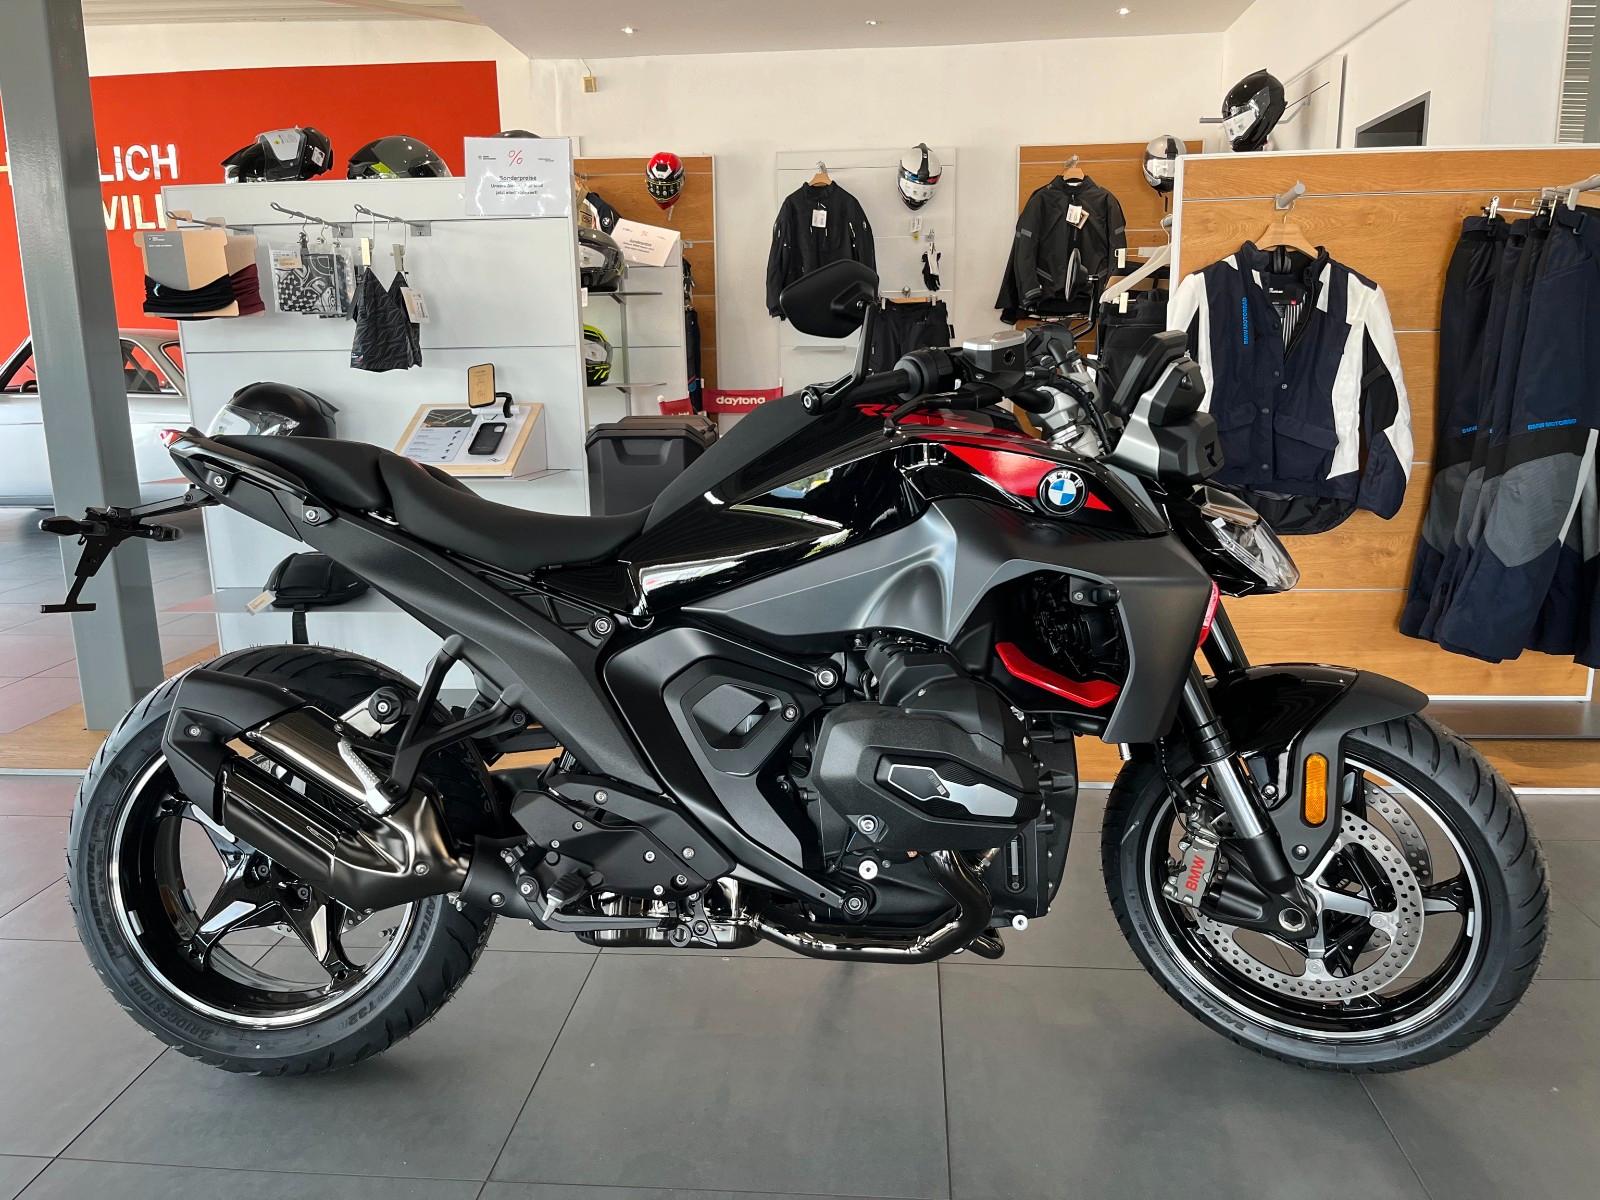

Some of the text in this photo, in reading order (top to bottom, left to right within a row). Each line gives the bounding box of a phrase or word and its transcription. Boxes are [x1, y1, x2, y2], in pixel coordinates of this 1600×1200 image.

[715, 395, 766, 406] daytona
[1047, 470, 1083, 488] BMW
[1185, 854, 1205, 891] BMW
